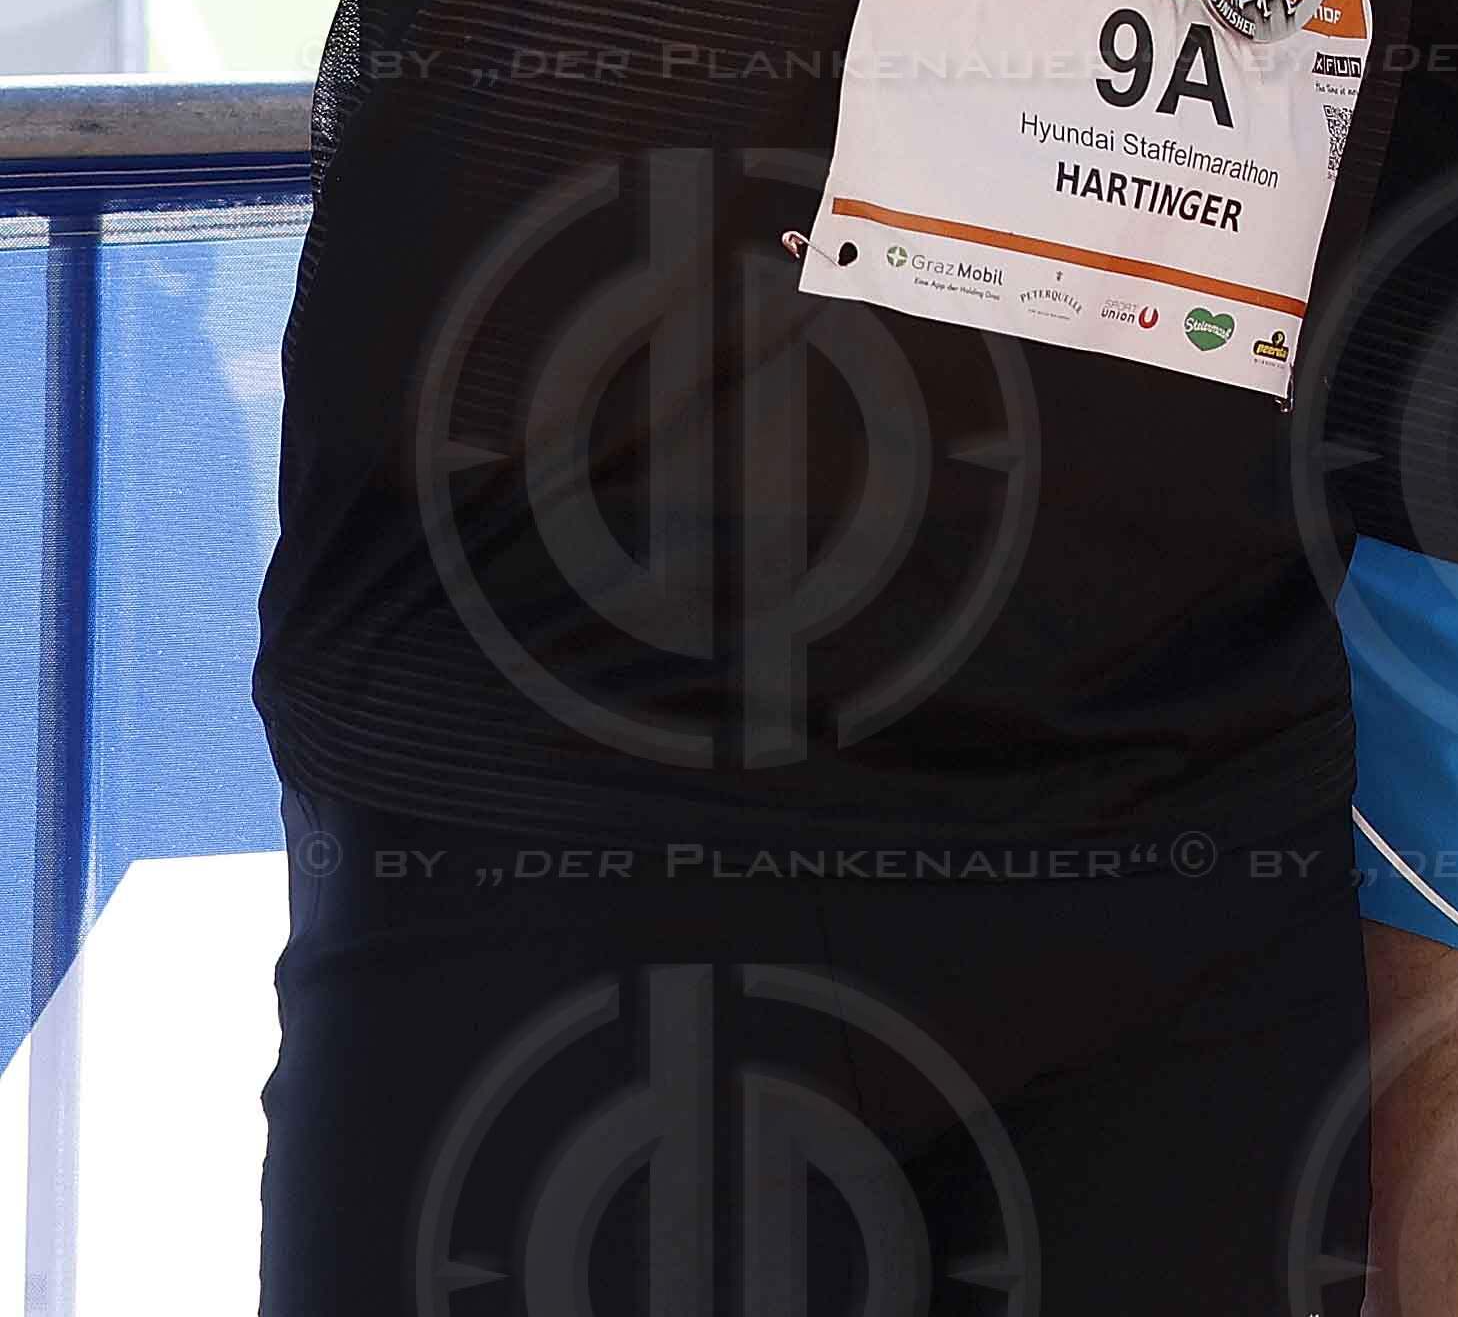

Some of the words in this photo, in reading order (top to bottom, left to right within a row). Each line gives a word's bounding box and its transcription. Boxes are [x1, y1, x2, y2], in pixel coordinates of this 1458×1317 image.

[1096, 8, 1234, 129] 9A
[1020, 111, 1115, 153] Hyundai
[1123, 132, 1280, 190] Staffelmarathon
[1055, 160, 1244, 233] HARTINGER
[1020, 288, 1084, 314] PETERQUELLE
